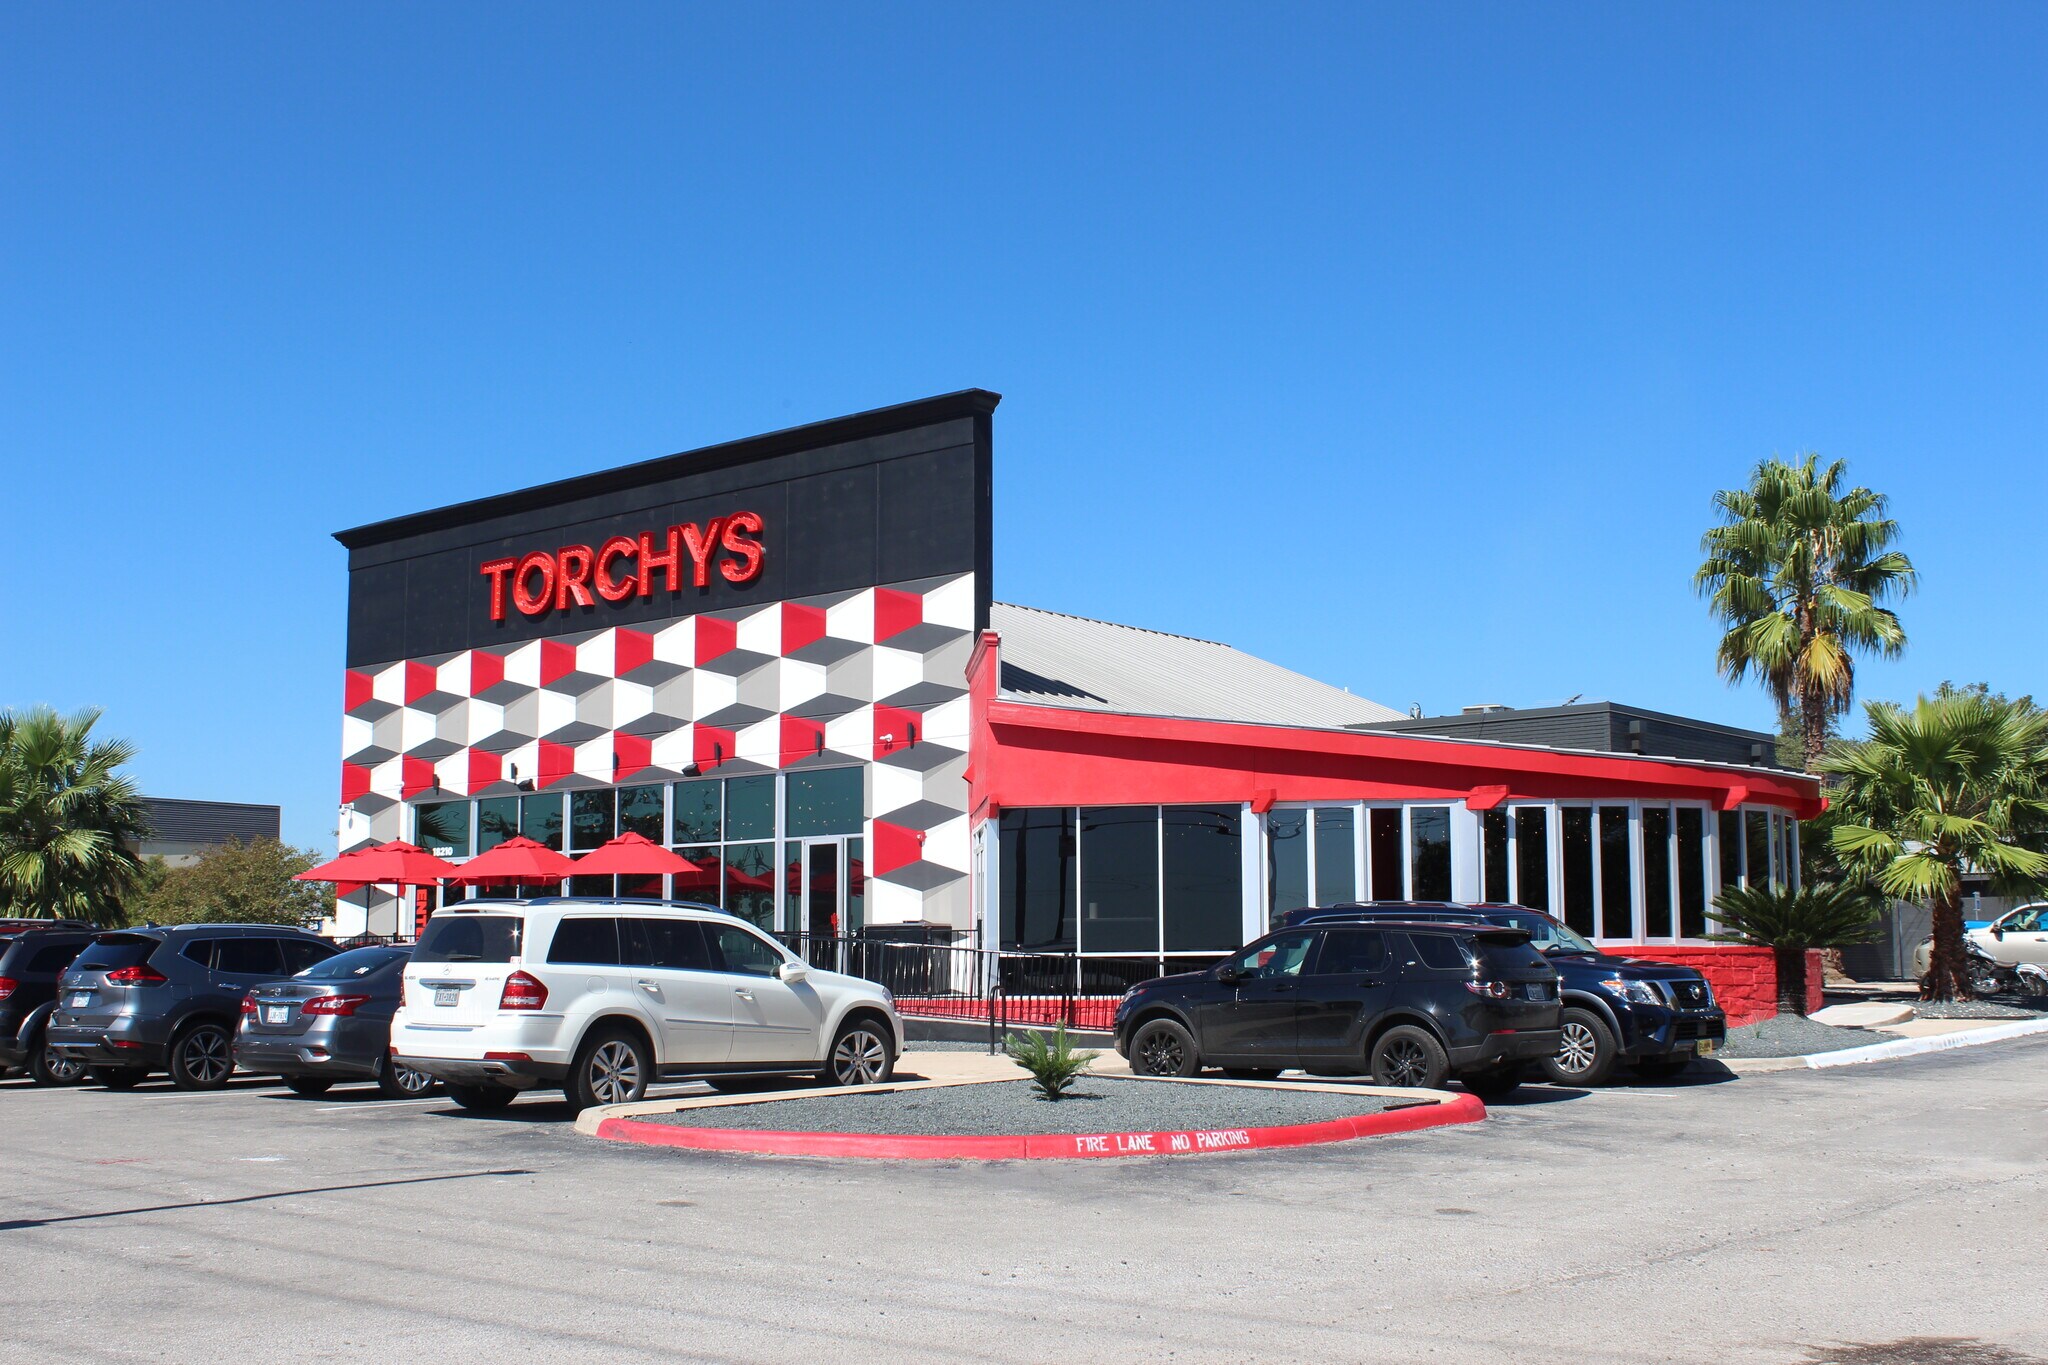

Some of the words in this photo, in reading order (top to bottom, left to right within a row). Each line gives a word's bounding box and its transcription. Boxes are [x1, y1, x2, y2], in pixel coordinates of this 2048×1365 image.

[480, 511, 764, 620] TORCHYS
[432, 846, 454, 857] 18210
[415, 888, 428, 942] ENTE
[1076, 1136, 1109, 1153] FIRE
[1116, 1135, 1155, 1152] LANE
[1171, 1134, 1190, 1151] NO
[1196, 1130, 1250, 1149] PARKING
